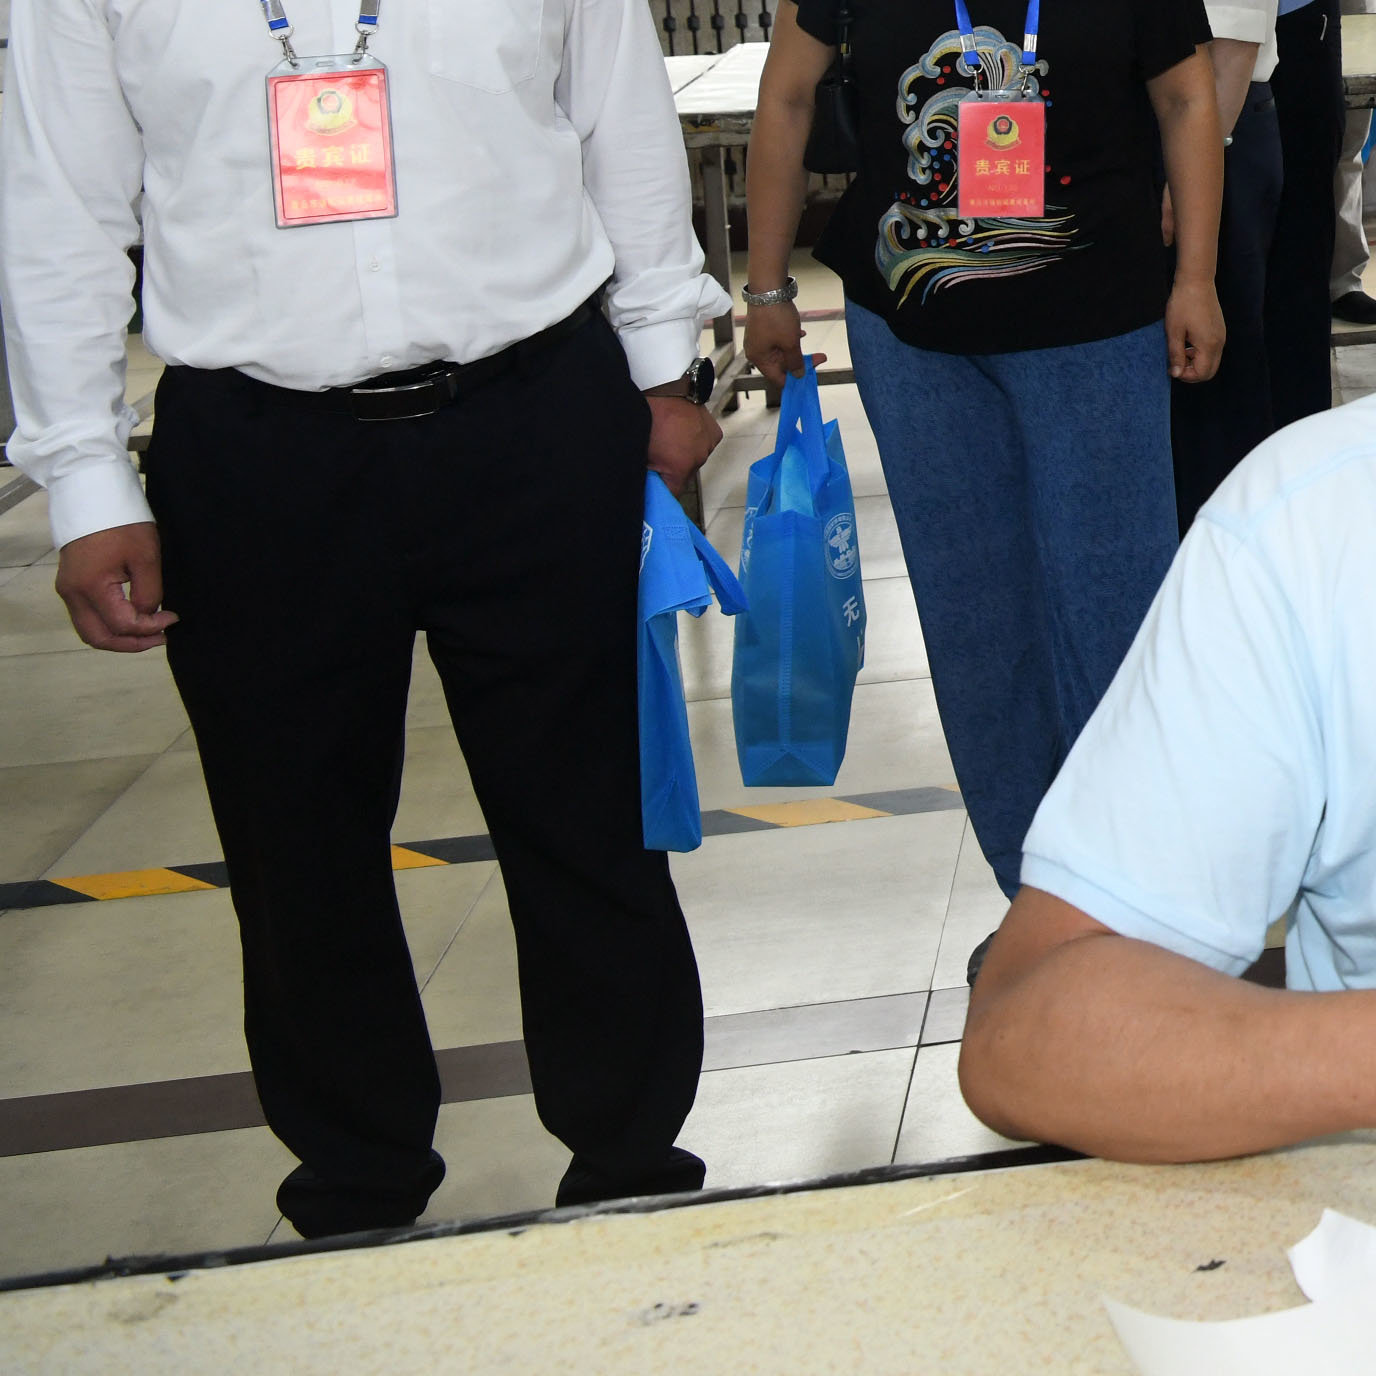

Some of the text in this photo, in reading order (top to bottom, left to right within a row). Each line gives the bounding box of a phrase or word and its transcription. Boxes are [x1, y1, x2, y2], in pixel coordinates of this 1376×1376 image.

[295, 143, 373, 170] 贵宾证
[975, 159, 1032, 176] 贵宾证
